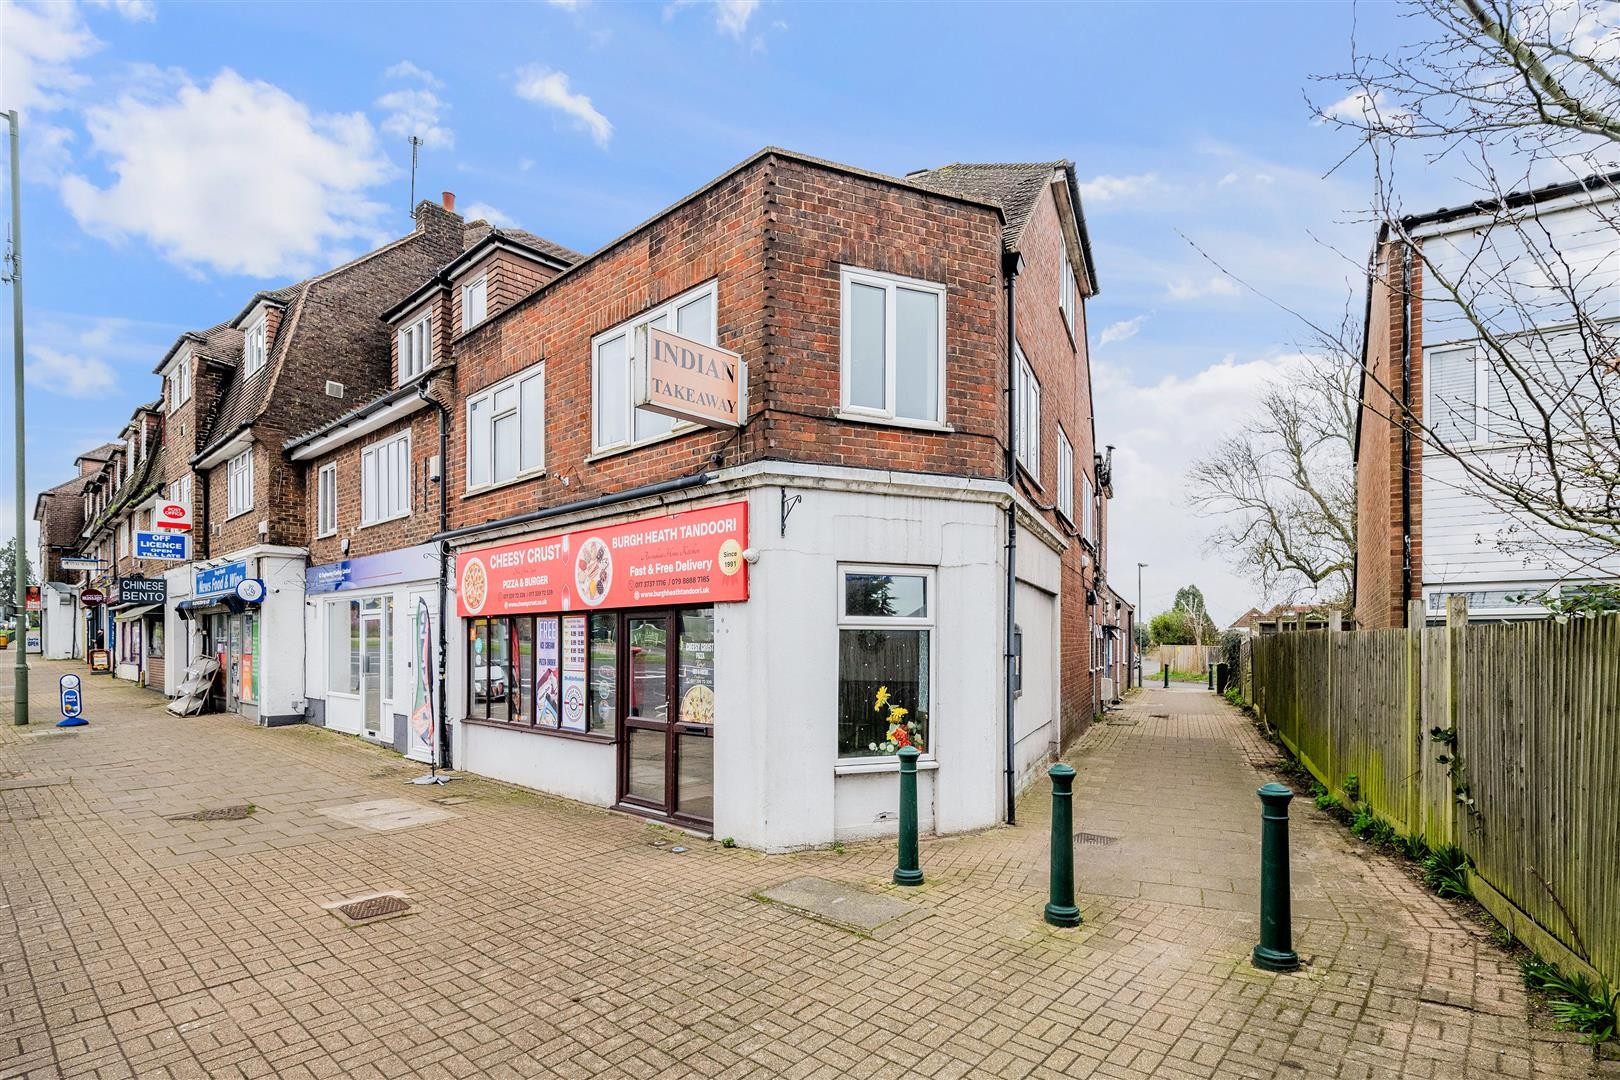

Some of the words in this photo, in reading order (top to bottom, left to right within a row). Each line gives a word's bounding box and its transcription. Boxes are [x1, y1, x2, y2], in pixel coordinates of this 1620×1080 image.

[654, 339, 735, 383] INDIAN
[652, 377, 737, 414] TAKEAWAY
[612, 532, 643, 549] BURGH
[645, 527, 677, 544] HEATH
[680, 517, 737, 539] TANDOORI
[140, 541, 182, 549] LICENCE
[490, 549, 526, 569] CHEESY
[527, 544, 561, 564] CRUST
[629, 565, 646, 577] Fast
[647, 563, 654, 575] &
[655, 561, 674, 574] Free
[675, 558, 713, 573] Delivery
[122, 580, 164, 591] CHINESE
[199, 580, 211, 593] News
[212, 575, 224, 591] Food
[224, 574, 229, 588] &
[502, 579, 519, 589] PIZZA
[519, 578, 524, 588] &
[524, 575, 549, 587] BURGER
[683, 576, 696, 584] 8888
[122, 591, 164, 602] BENTO
[539, 621, 556, 640] FREE
